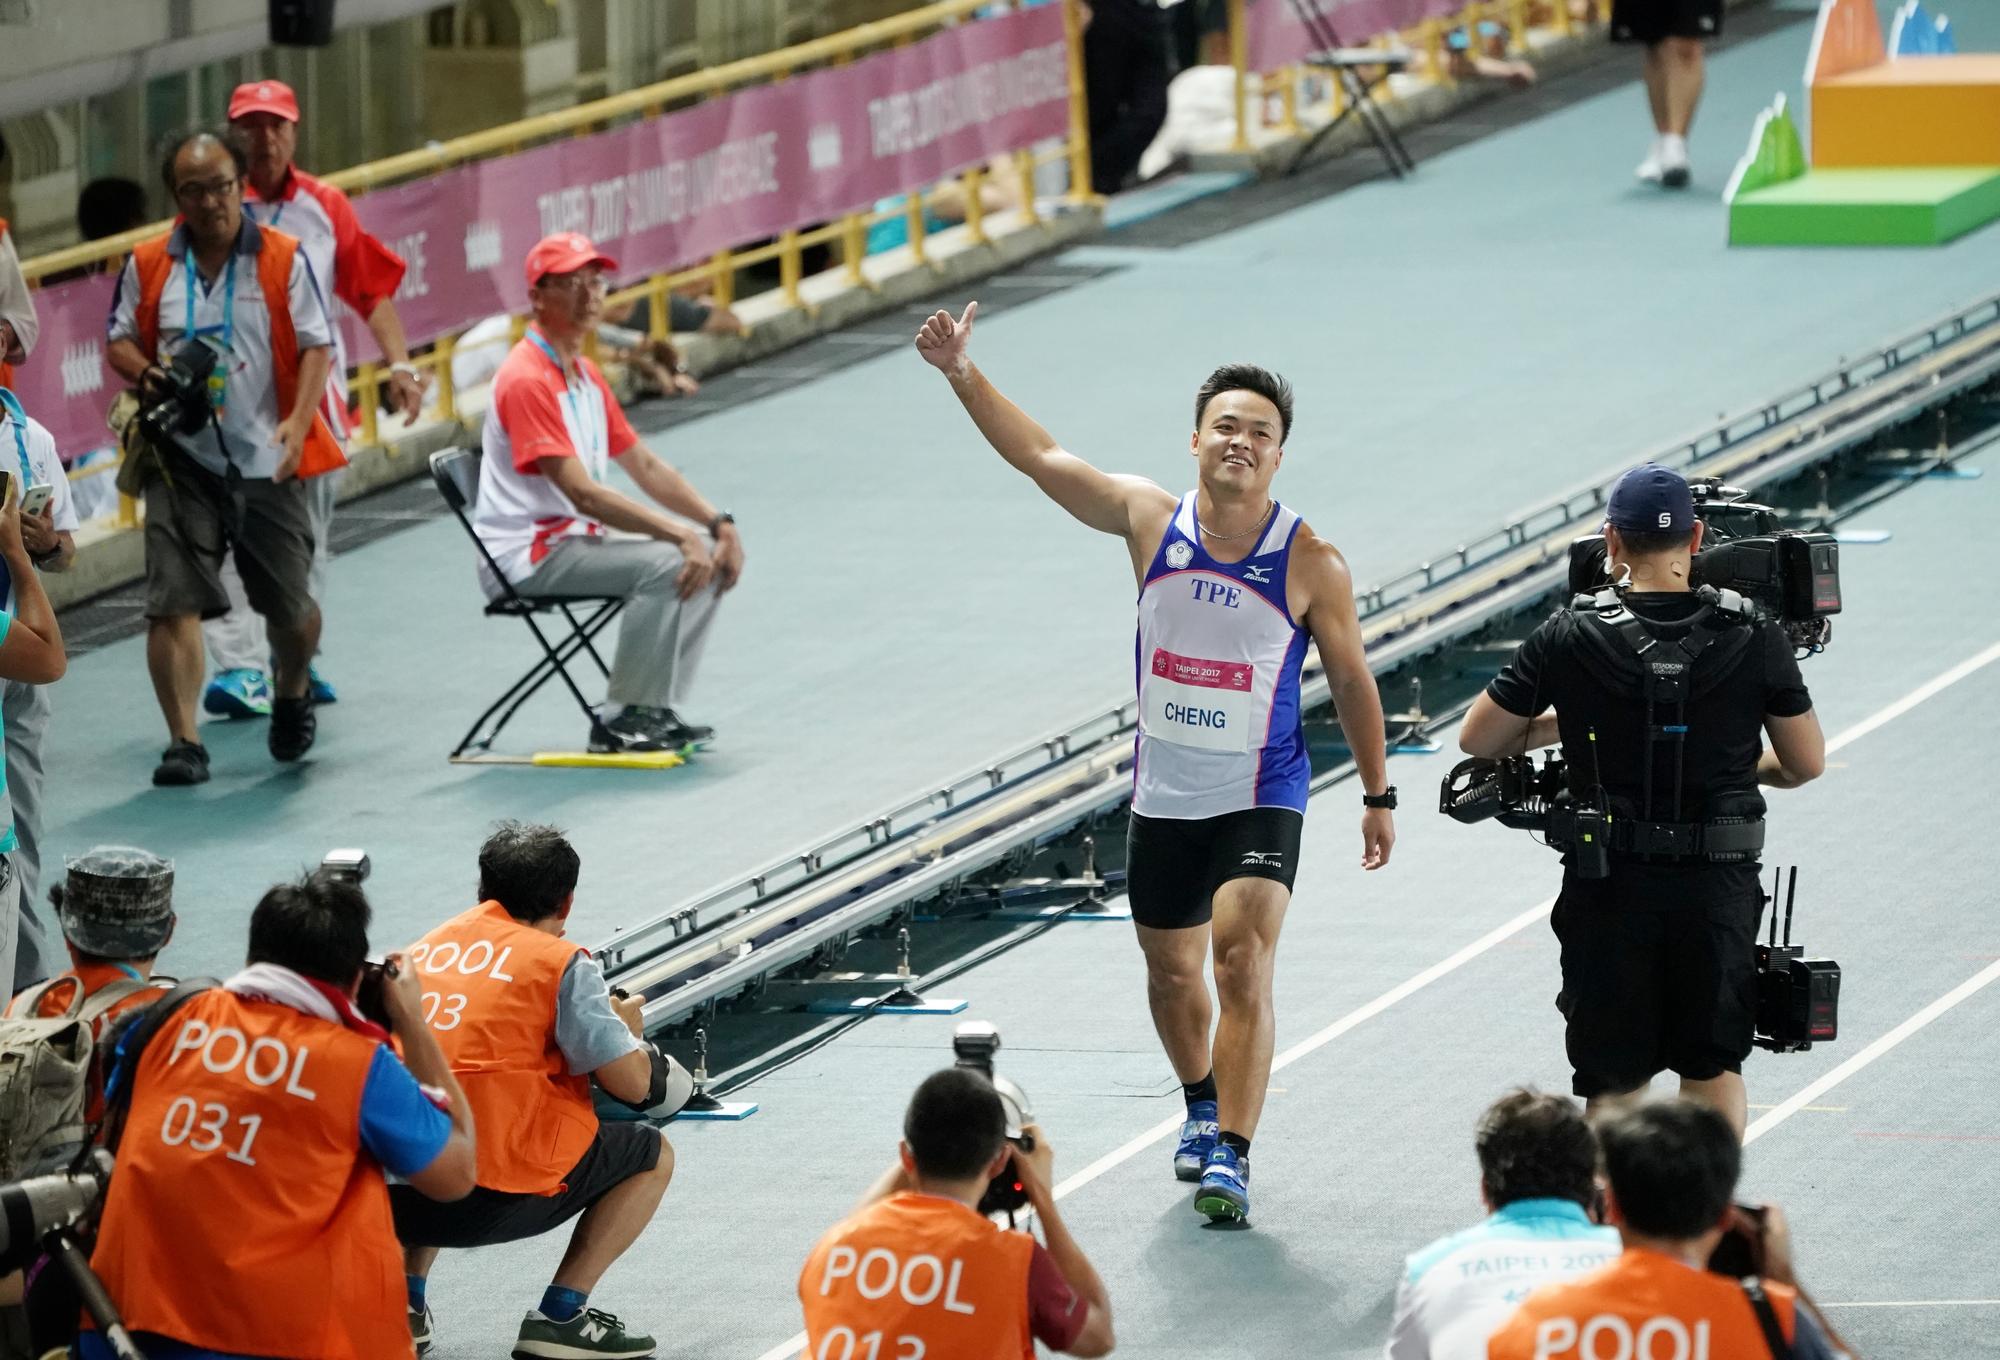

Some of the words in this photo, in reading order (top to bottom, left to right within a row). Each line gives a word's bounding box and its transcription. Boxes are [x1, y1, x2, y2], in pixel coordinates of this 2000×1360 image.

[1191, 578, 1241, 609] TPE
[1175, 663, 1199, 675] TAIPEI
[1201, 668, 1221, 678] 2017
[1165, 702, 1226, 729] CHENG
[411, 939, 514, 983] POOL
[167, 1018, 317, 1102] POOL
[160, 1095, 263, 1167] 031
[819, 1245, 976, 1316] POOL
[1458, 1254, 1549, 1277] TAIPEI
